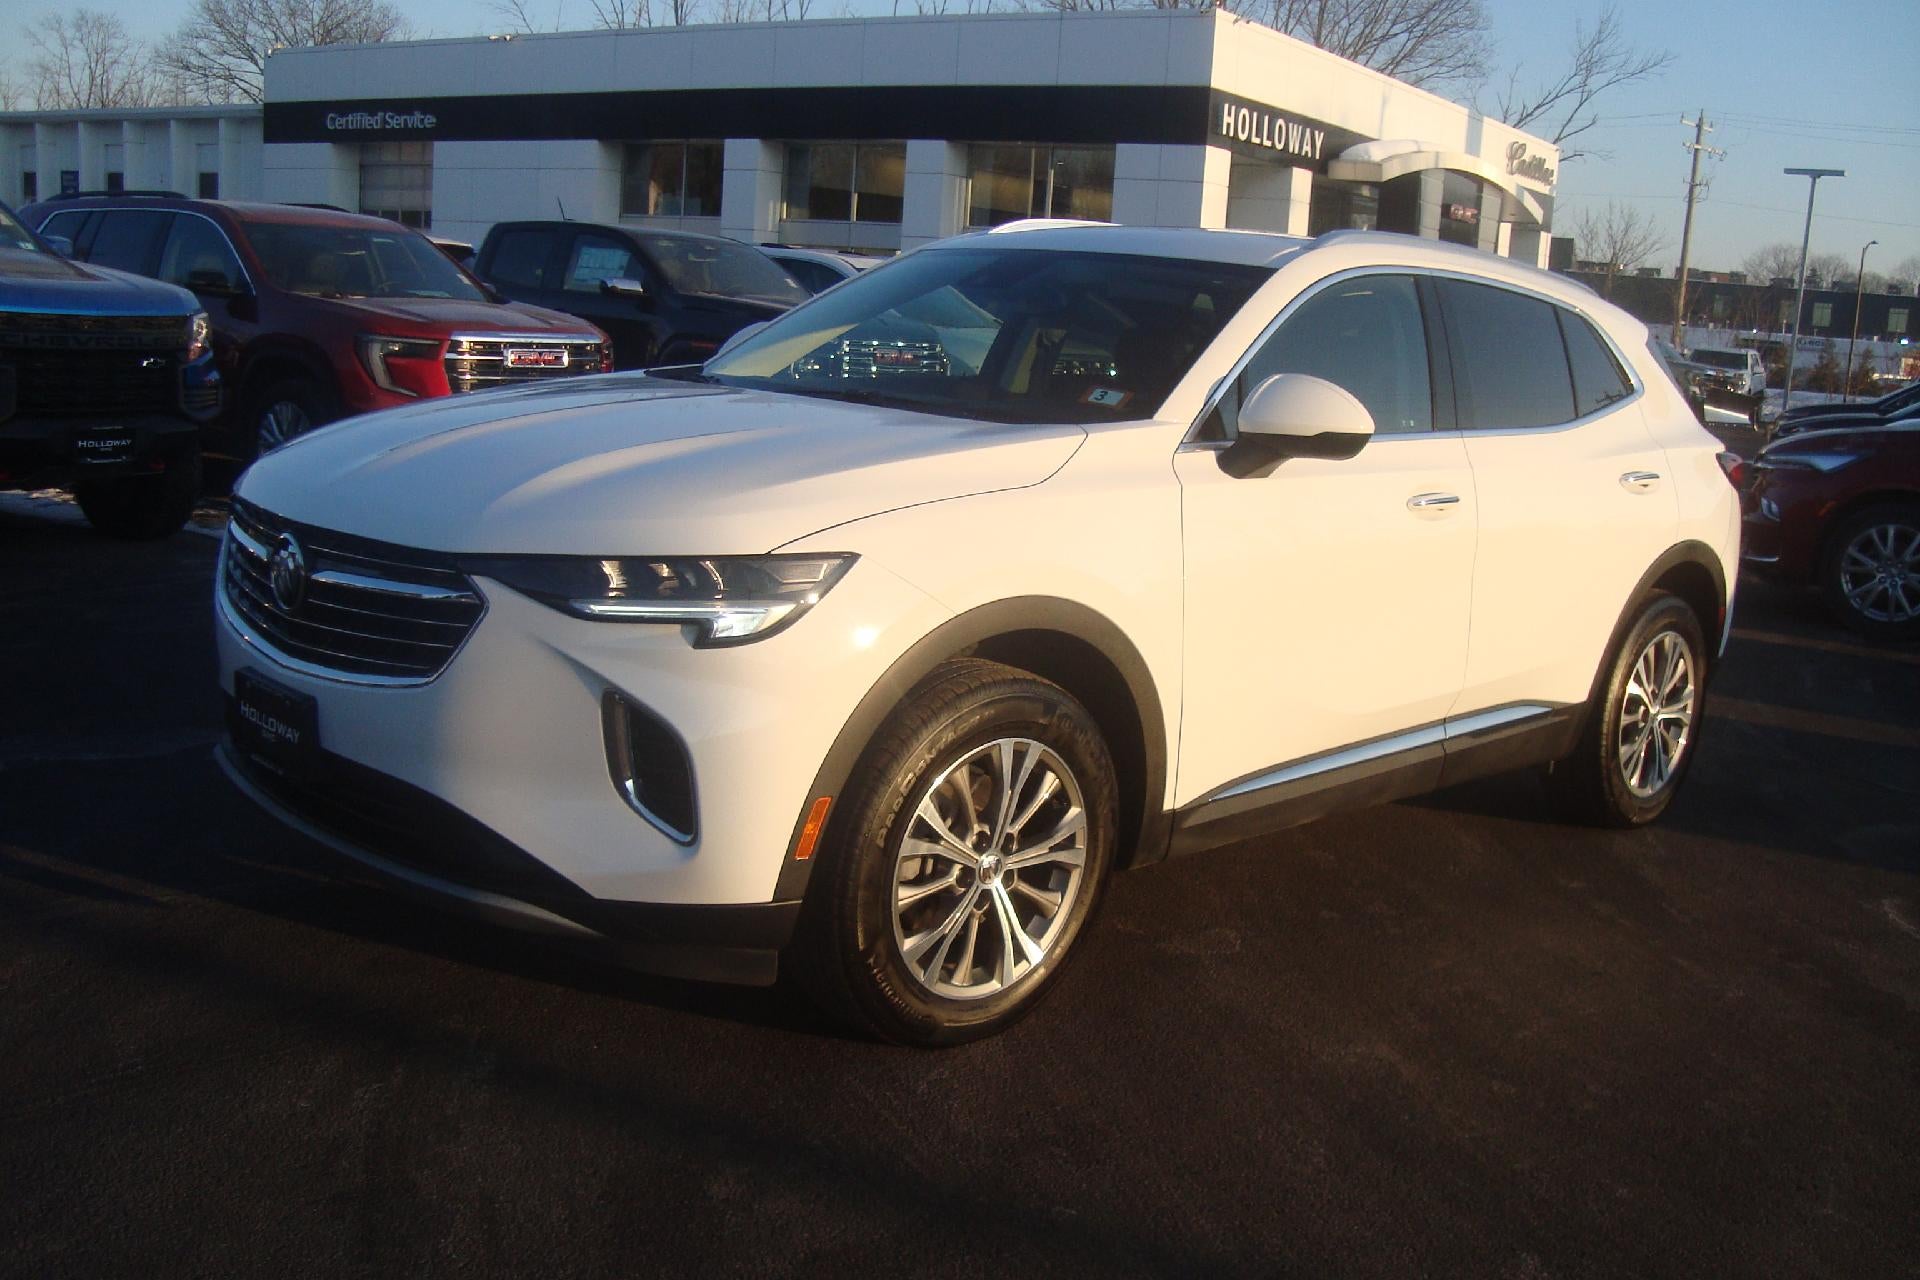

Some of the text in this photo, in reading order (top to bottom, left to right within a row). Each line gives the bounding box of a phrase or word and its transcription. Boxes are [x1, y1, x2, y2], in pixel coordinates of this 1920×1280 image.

[327, 111, 435, 130] Certified Service
[1222, 103, 1324, 160] HOLLOWAY
[512, 351, 565, 365] GMC
[1094, 390, 1109, 401] 3
[78, 439, 132, 448] HOLLOWAY
[240, 700, 300, 743] HOLLOWAY
